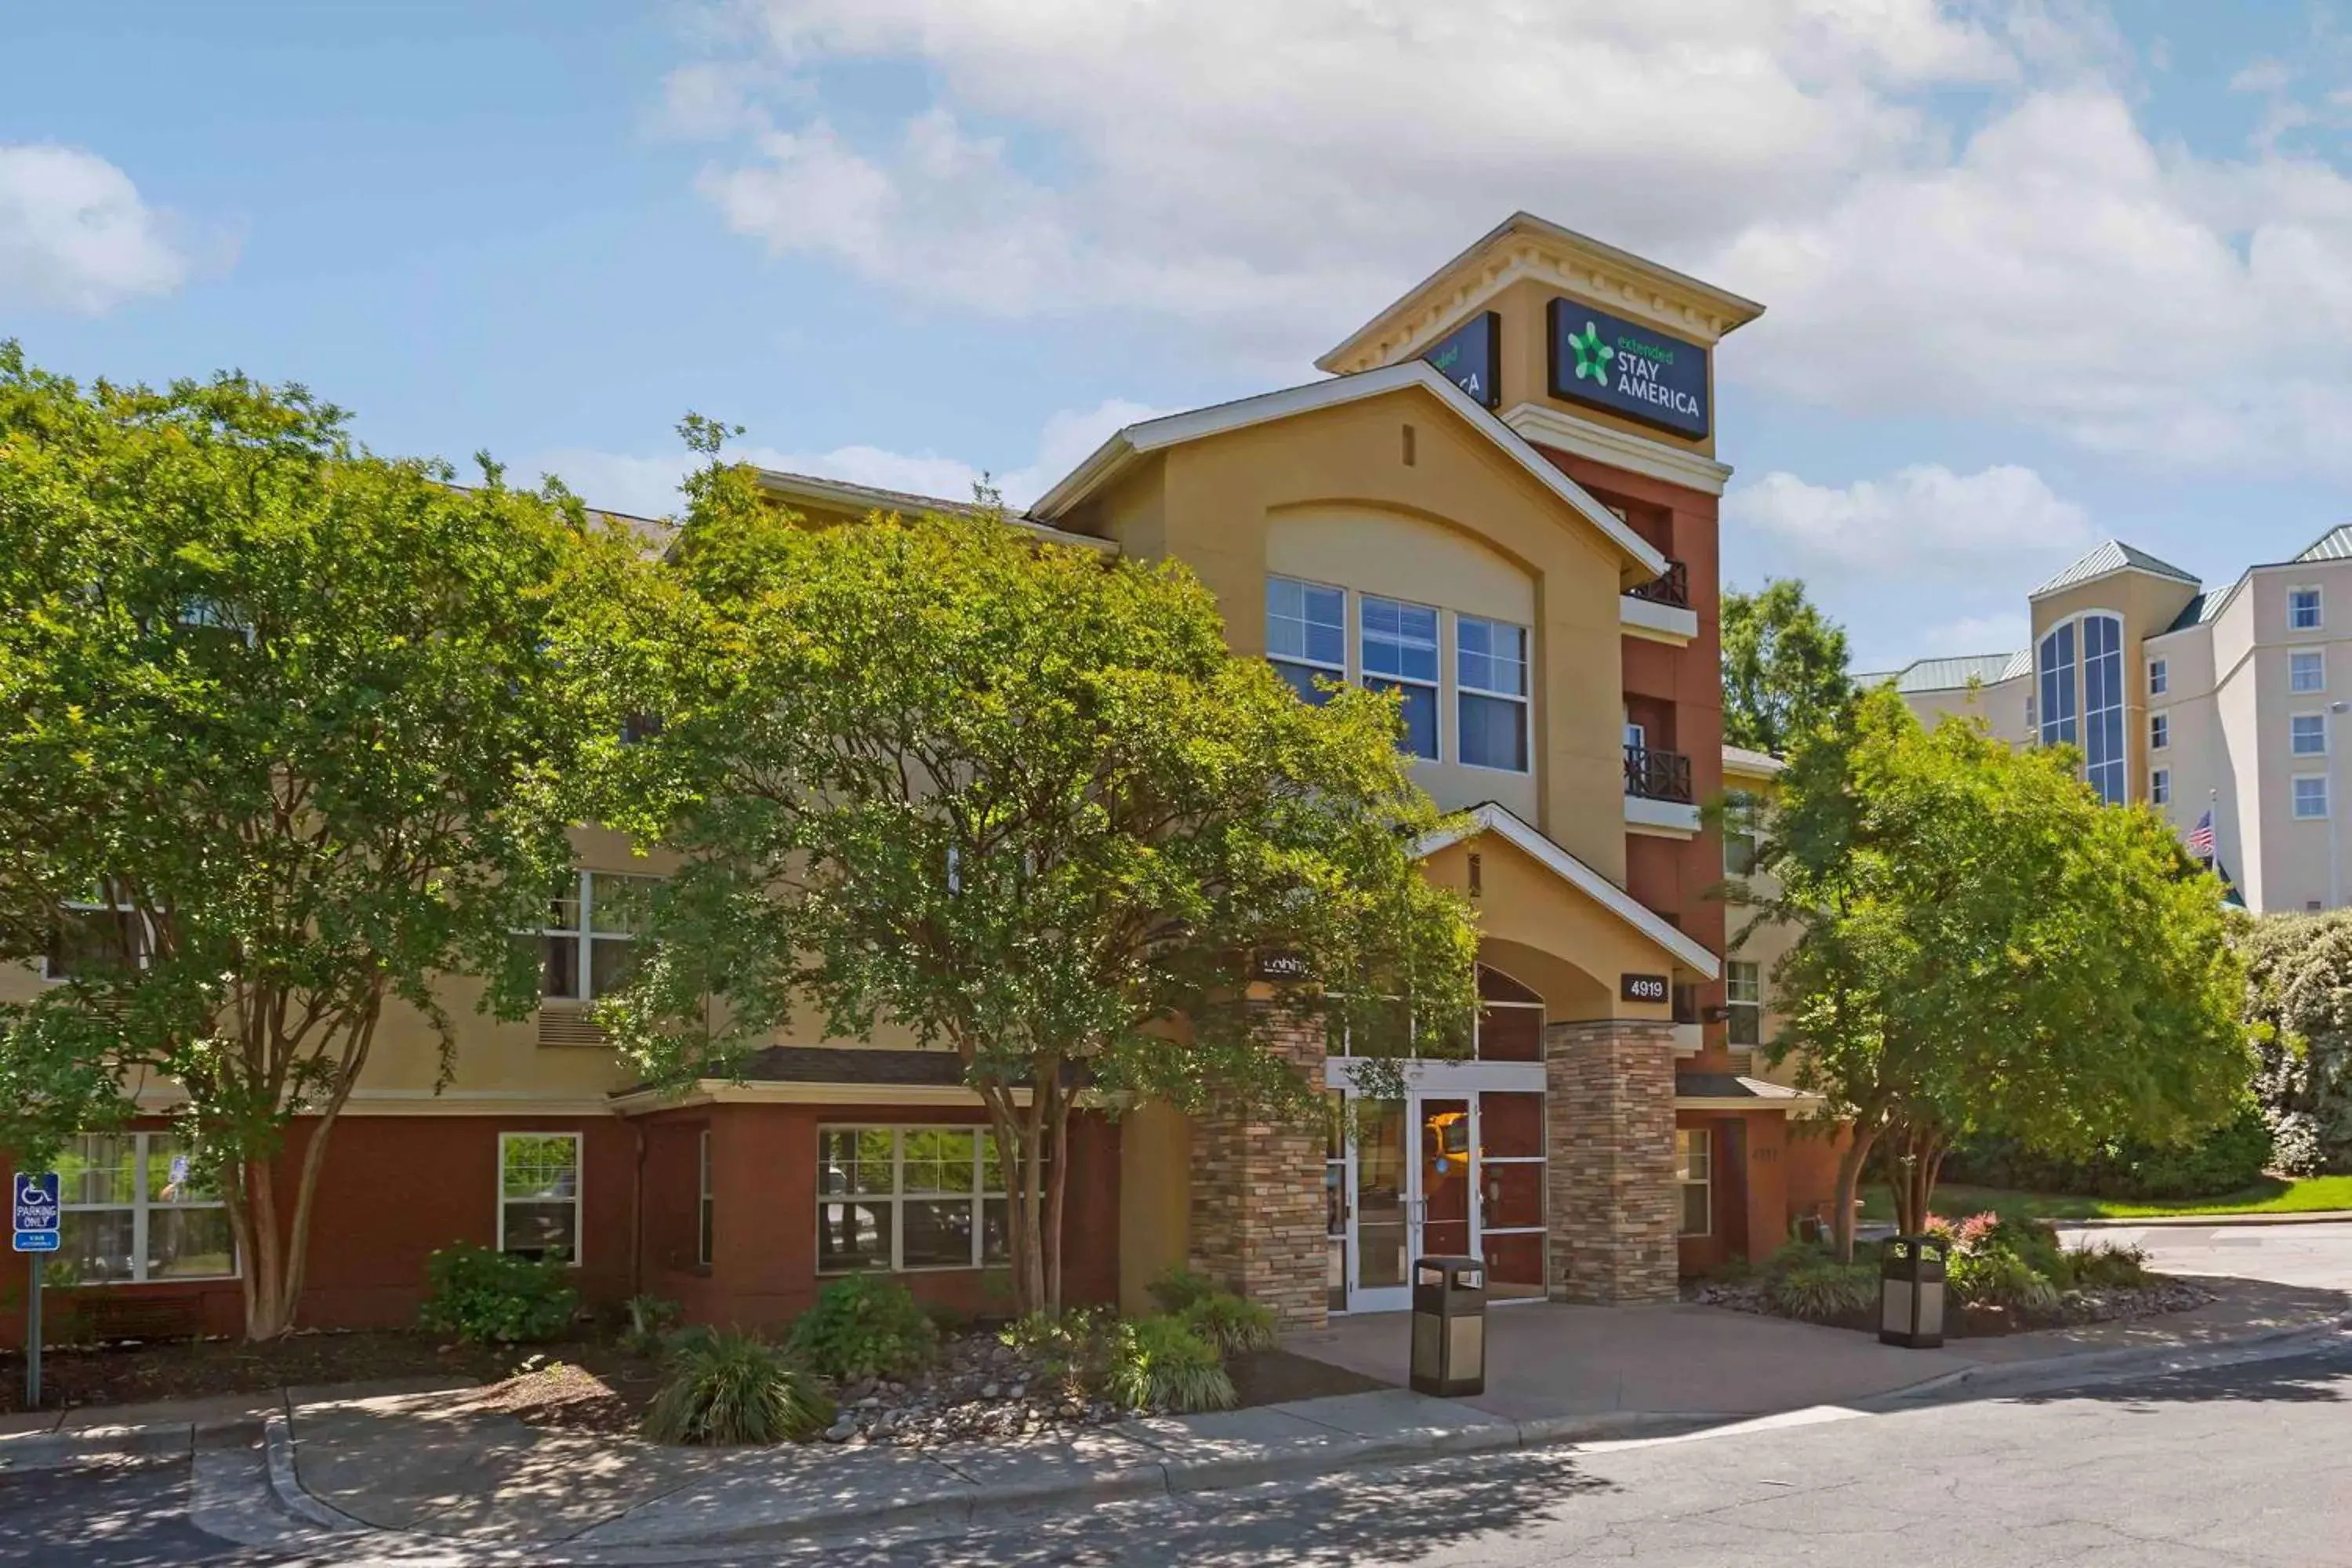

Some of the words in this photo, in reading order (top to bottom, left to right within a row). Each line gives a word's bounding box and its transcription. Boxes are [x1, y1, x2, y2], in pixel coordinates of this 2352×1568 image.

[1618, 336, 1674, 365] extended
[1618, 351, 1660, 382] STAY
[1617, 374, 1700, 417] AMERICA
[1631, 981, 1663, 996] 4919
[17, 1205, 56, 1216] PARKING
[24, 1216, 49, 1228] ONLY
